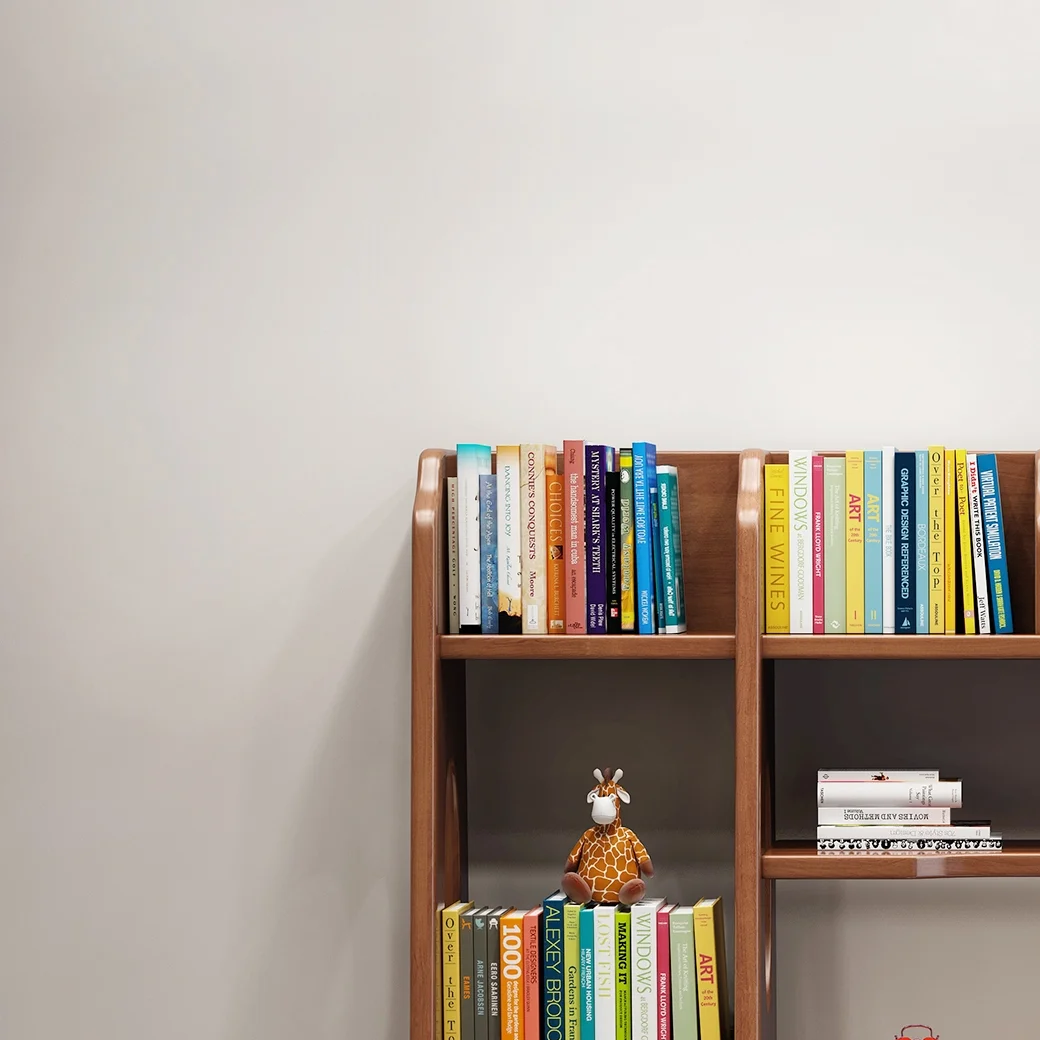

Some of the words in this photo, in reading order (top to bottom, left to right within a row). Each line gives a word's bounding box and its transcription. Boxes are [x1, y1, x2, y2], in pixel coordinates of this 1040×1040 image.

[591, 451, 600, 491] MYSTERY
[900, 468, 909, 506] GRAPHIC
[932, 452, 941, 495] Over
[970, 467, 978, 493] Didn't
[980, 470, 994, 496] VIRTUAL
[549, 482, 562, 541] CHOICES
[570, 485, 579, 524] handsomest
[591, 494, 600, 505] AT
[770, 488, 784, 533] FINE
[794, 456, 807, 531] WINDOWS
[849, 494, 861, 522] ART
[867, 494, 879, 522] ART
[983, 498, 998, 522] PATIENT
[528, 501, 536, 559] CONQUESTS
[591, 506, 600, 544] SHARK'S
[901, 509, 909, 540] DESIGN
[932, 510, 940, 540] the
[986, 524, 1002, 560] SIMULATION
[592, 545, 600, 573] TEETH
[918, 524, 926, 571] BORDEAUX
[770, 543, 785, 611] WINES
[901, 543, 909, 599] REFERENCED
[932, 552, 940, 588] Top
[977, 596, 986, 609] Jeff
[979, 610, 987, 629] Watts
[445, 918, 454, 962] Over
[503, 924, 521, 980] 1000
[546, 905, 561, 973] ALEXEY
[597, 914, 611, 956] LOST
[618, 922, 626, 970] MAKING
[636, 913, 651, 994] WINDOWS
[568, 966, 576, 1005] Gardens
[598, 962, 611, 998] FISH
[618, 973, 627, 985] IT
[699, 954, 714, 984] ART
[569, 1007, 577, 1016] in
